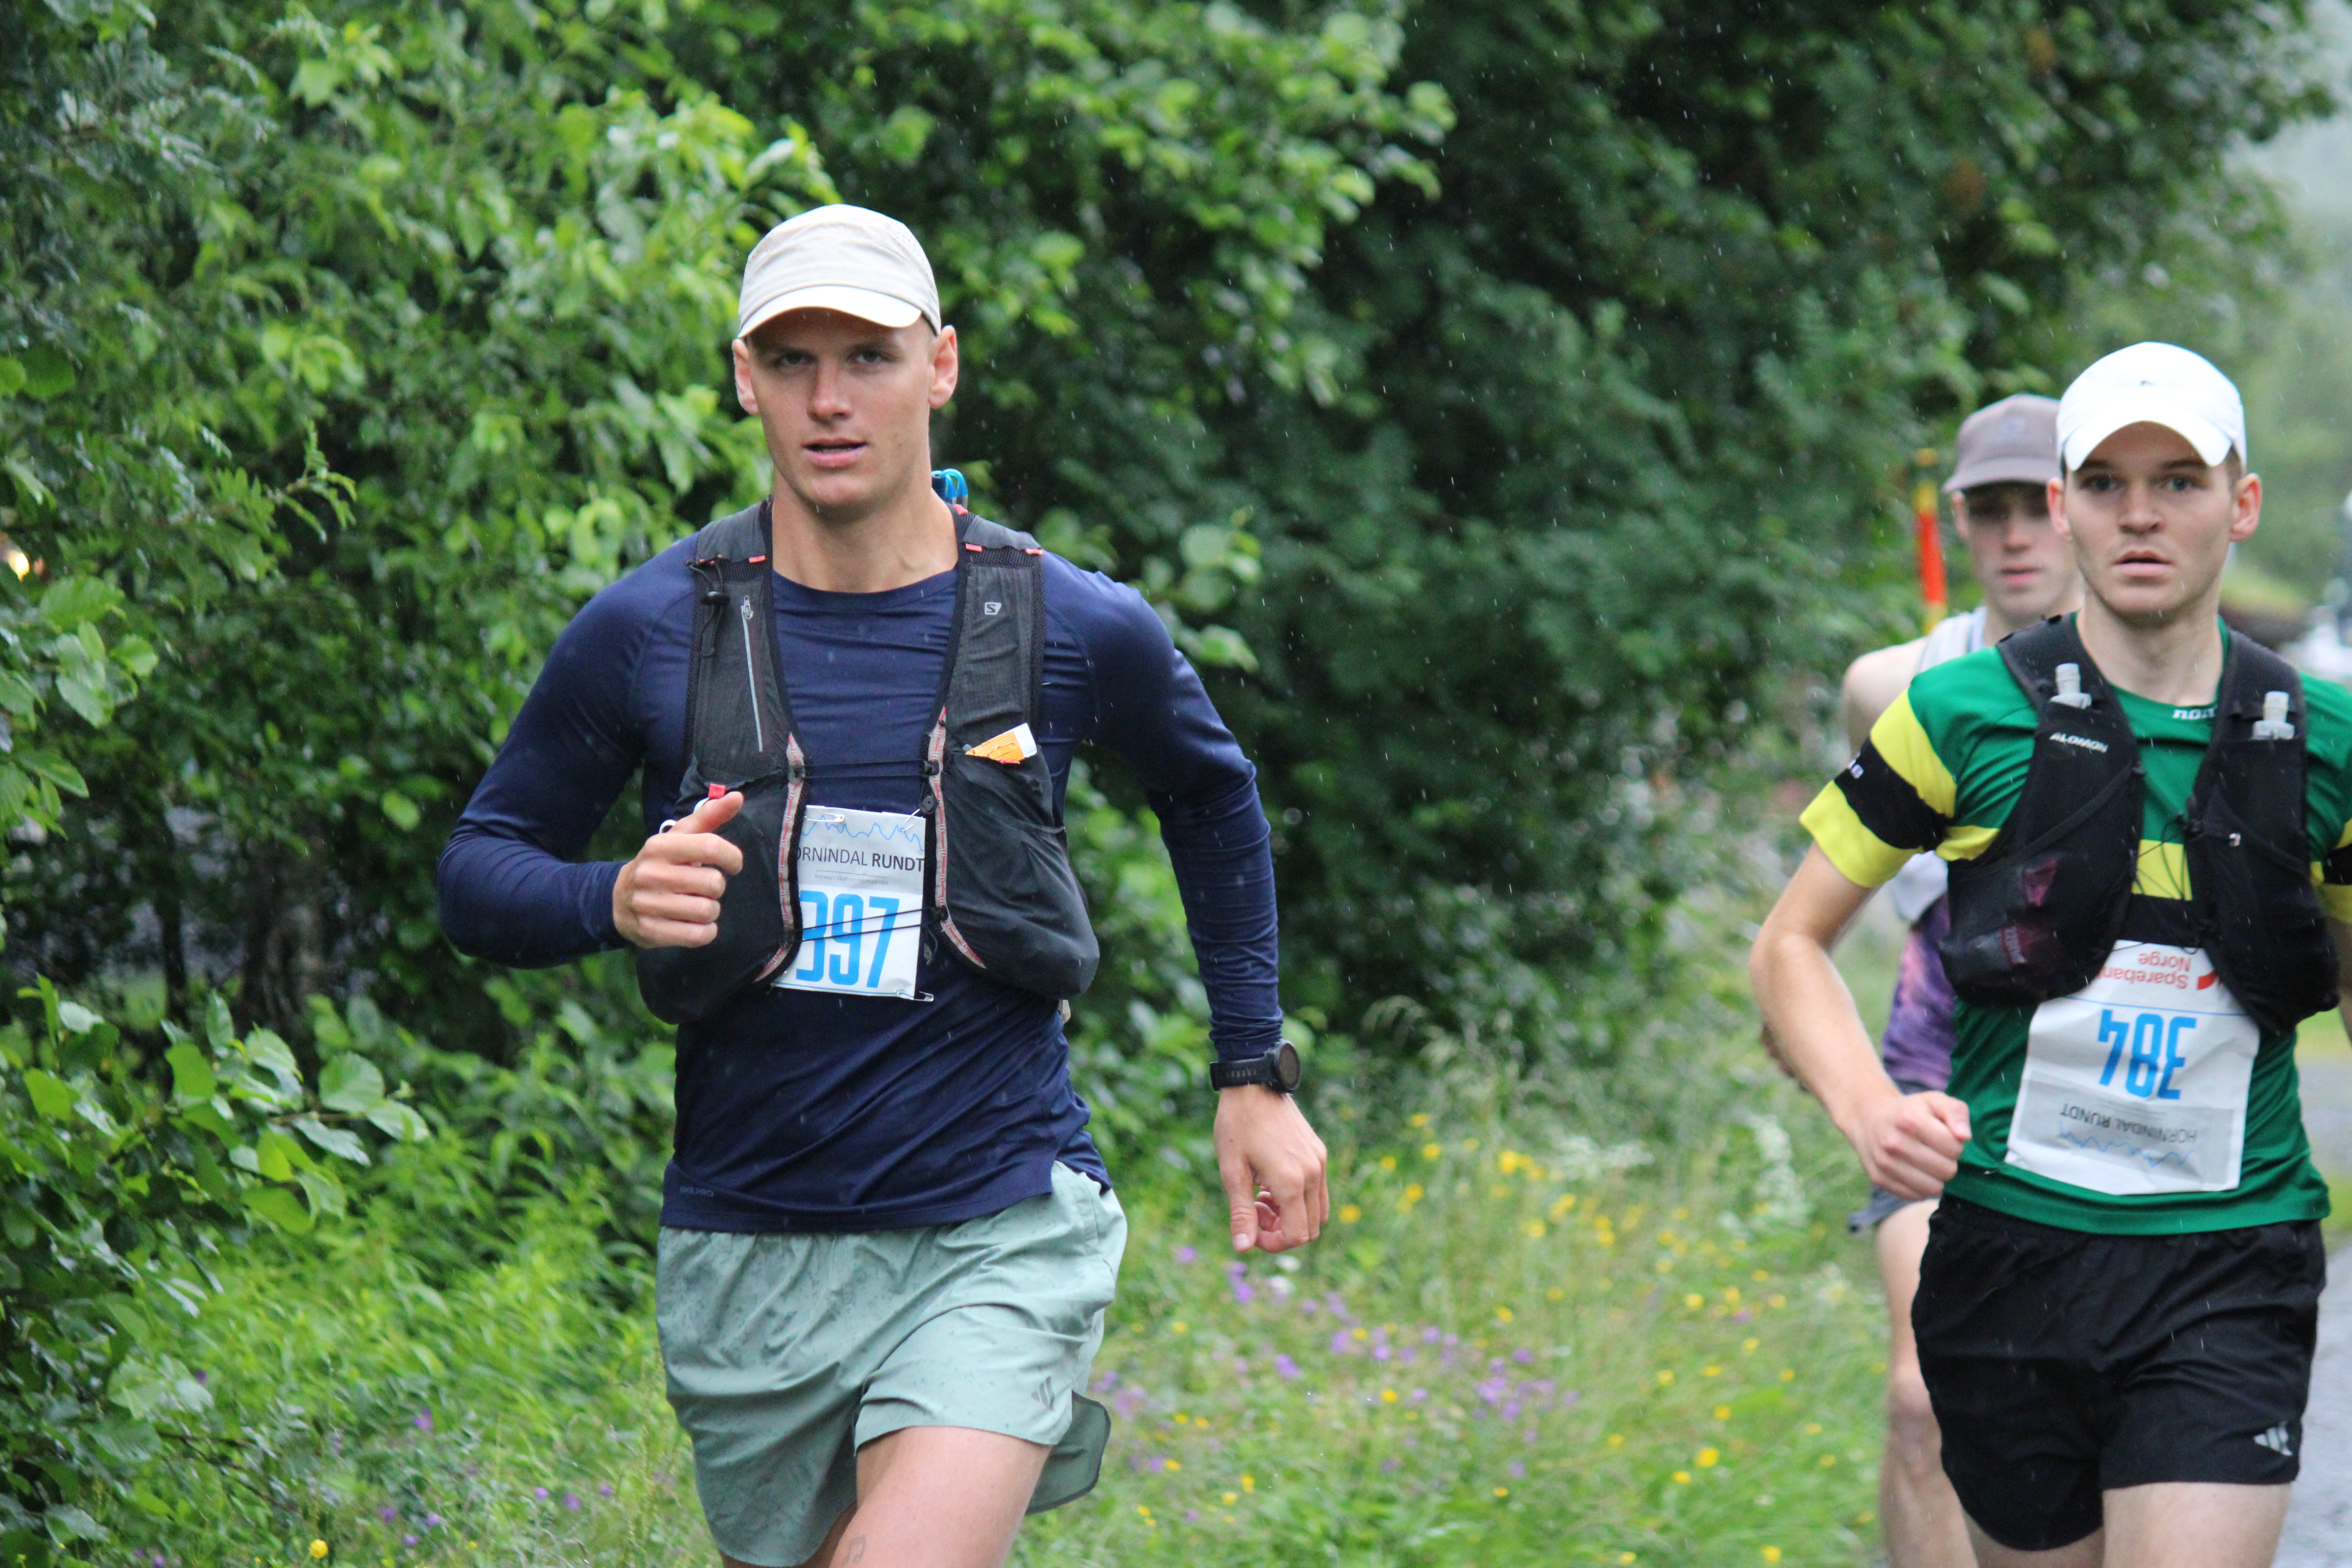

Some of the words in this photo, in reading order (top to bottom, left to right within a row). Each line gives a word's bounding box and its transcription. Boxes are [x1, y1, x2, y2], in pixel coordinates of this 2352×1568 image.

[872, 853, 924, 872] RUNDT
[796, 890, 900, 988] 397
[2138, 951, 2192, 972] Norge
[2098, 964, 2189, 989] Spareban
[2098, 1009, 2197, 1100] 384
[2060, 1103, 2111, 1129] RUNDT
[695, 1188, 713, 1197] PRO
